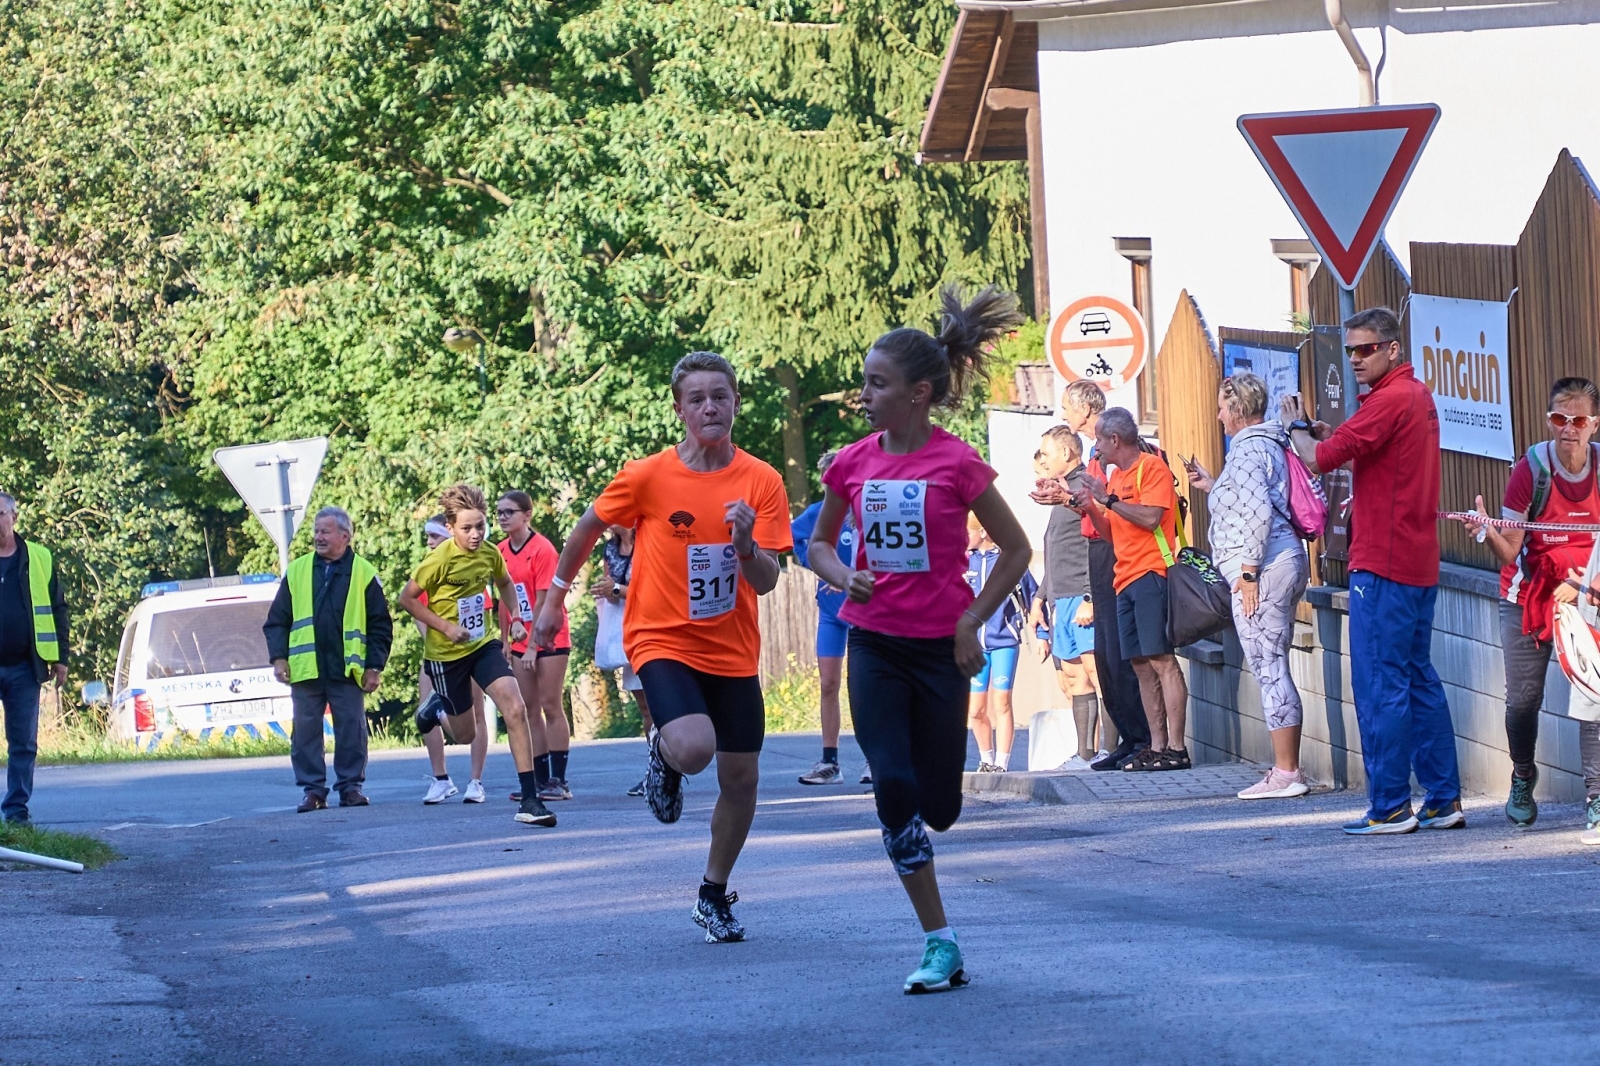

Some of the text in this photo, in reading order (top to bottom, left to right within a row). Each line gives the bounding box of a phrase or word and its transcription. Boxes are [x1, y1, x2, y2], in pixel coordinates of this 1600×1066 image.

[1422, 325, 1501, 404] pinguin
[1444, 405, 1469, 425] outdoors
[1470, 409, 1486, 428] since
[1487, 412, 1502, 431] 1989
[865, 504, 887, 512] CUP
[866, 521, 924, 549] 453
[690, 573, 735, 601] 311
